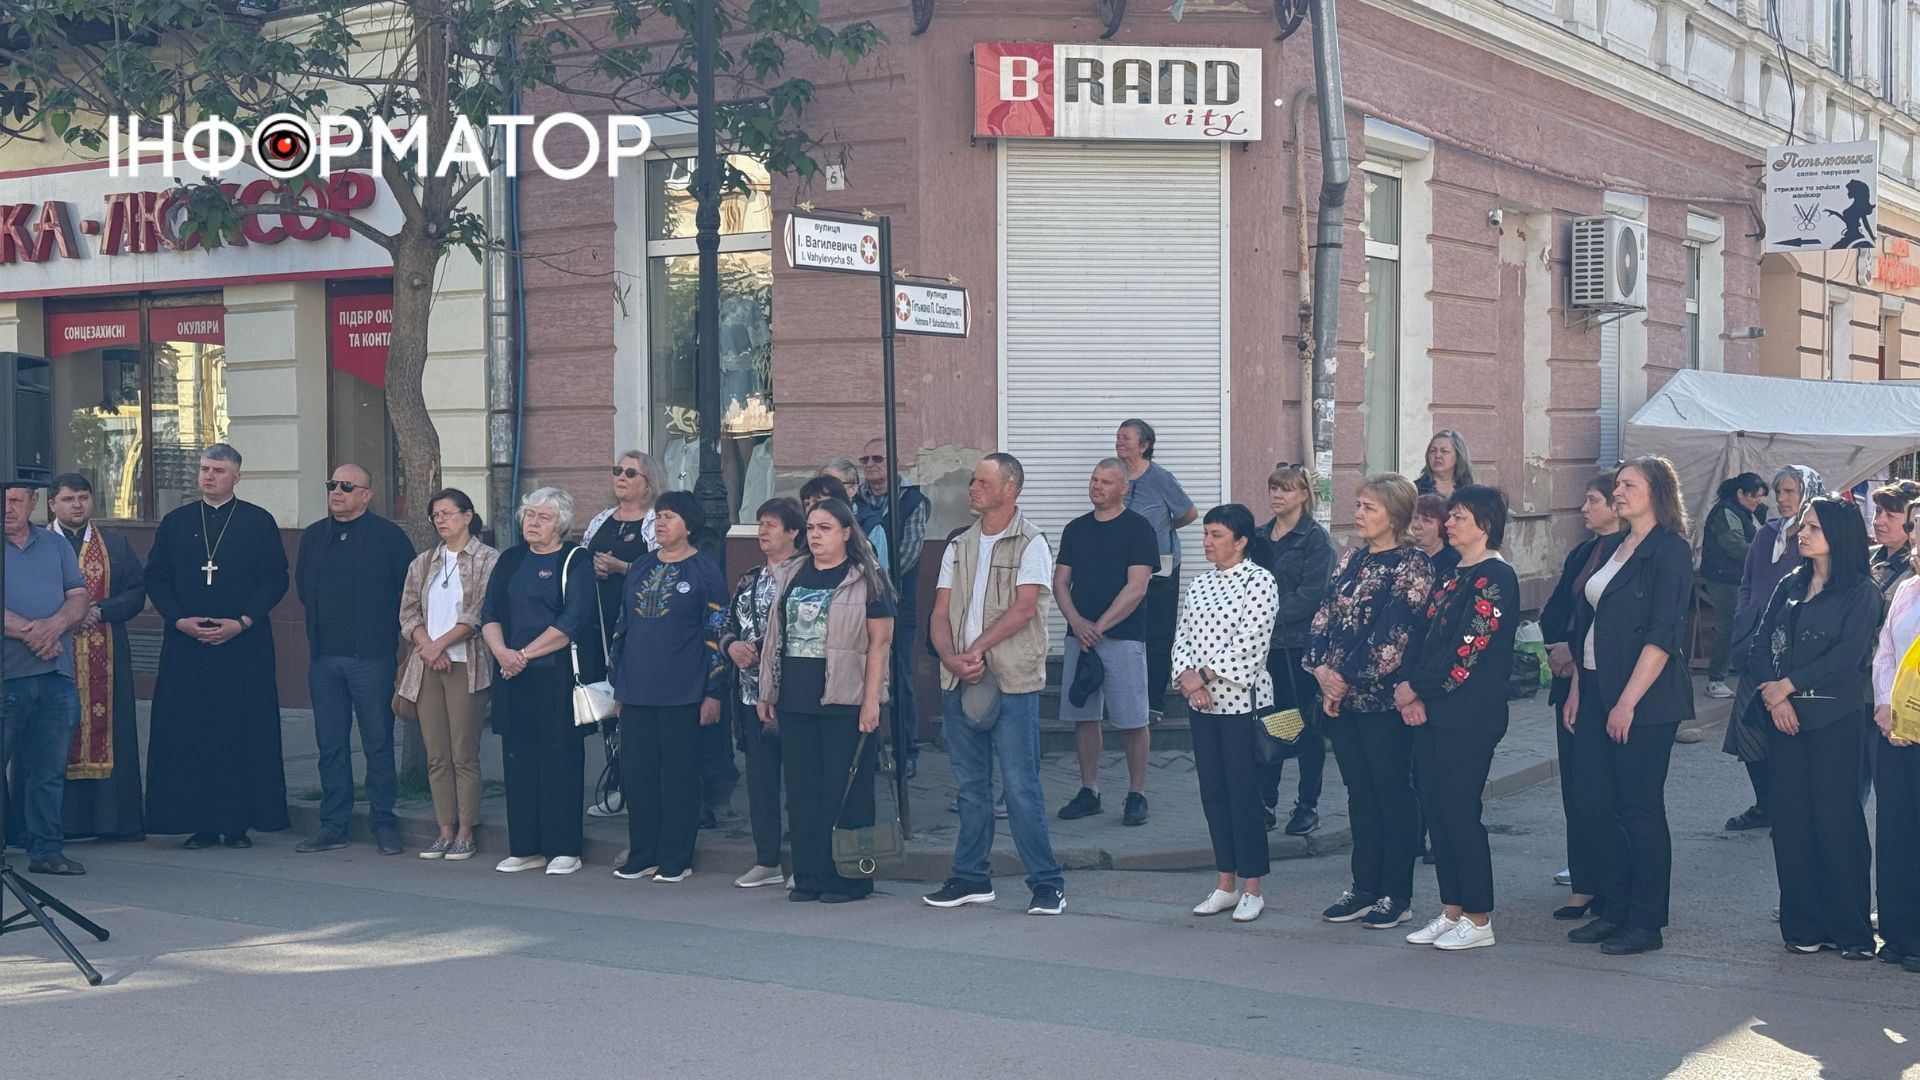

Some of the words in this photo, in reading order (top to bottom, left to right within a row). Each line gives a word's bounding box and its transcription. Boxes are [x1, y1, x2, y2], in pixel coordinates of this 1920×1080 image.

[1000, 56, 1240, 105] BRAND
[1164, 109, 1248, 136] city
[831, 171, 837, 184] 6
[815, 223, 841, 234] вулиця
[806, 235, 857, 253] Вагилевича
[807, 251, 845, 265] Vahylevycha
[927, 291, 948, 301] вулиця
[340, 310, 374, 328] ПІДБІР
[64, 324, 126, 341] СОНЦЕЗАХИСНІ
[177, 320, 219, 336] ОКУЛЯРИ
[349, 333, 360, 348] ТА
